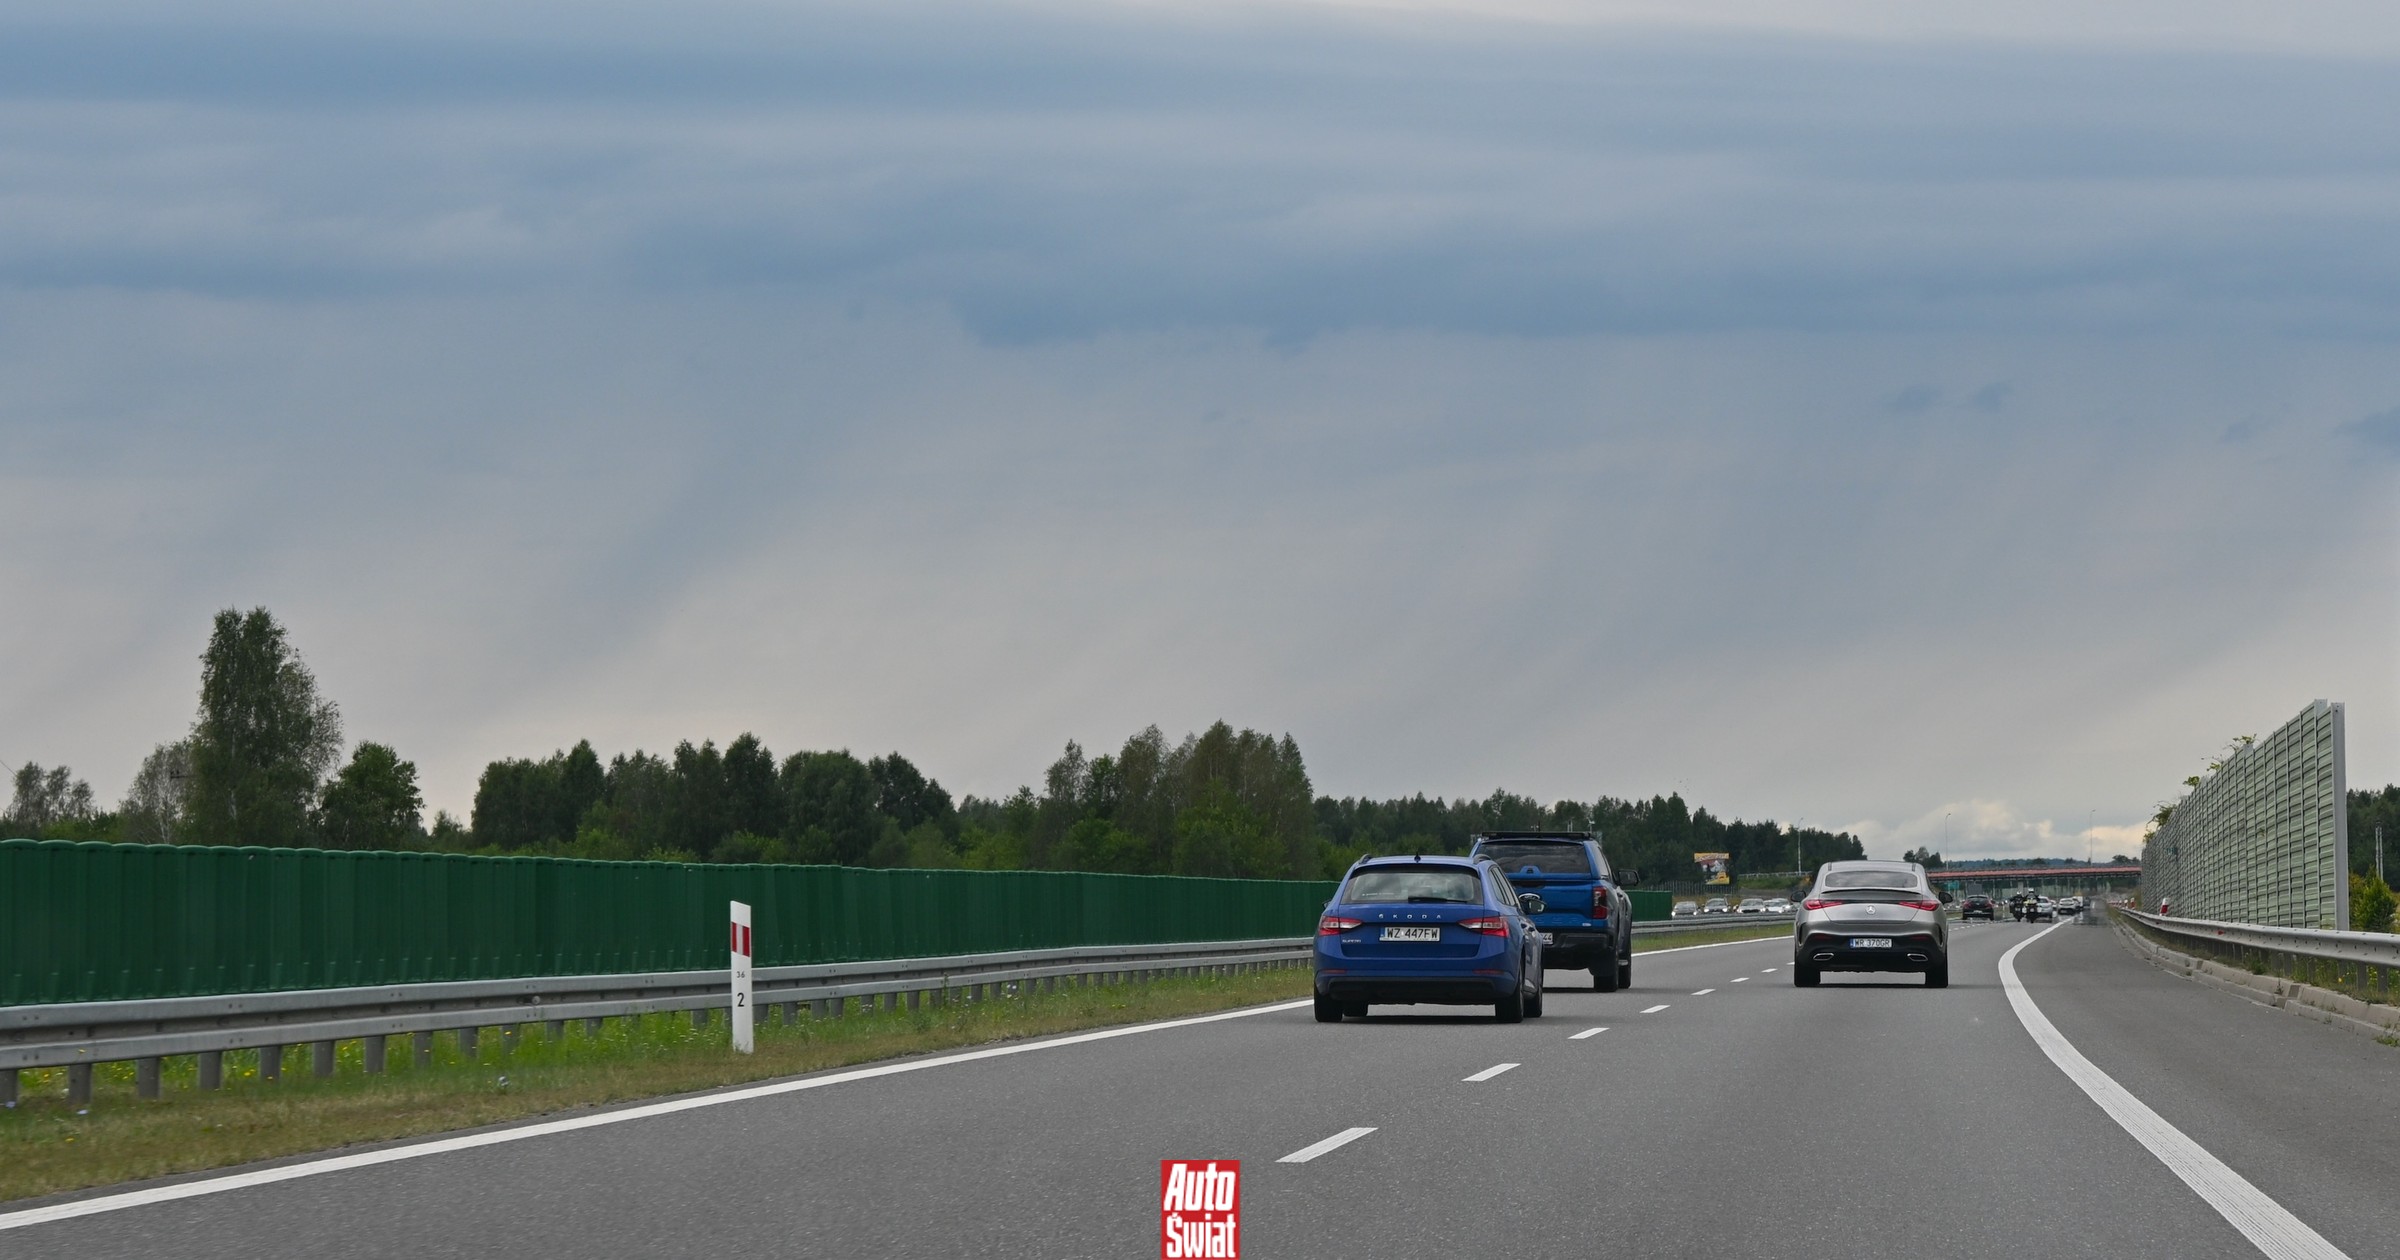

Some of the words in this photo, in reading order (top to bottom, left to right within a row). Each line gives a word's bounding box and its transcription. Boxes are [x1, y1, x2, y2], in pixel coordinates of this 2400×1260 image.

[1387, 928, 1401, 939] WZ
[1404, 928, 1438, 939] 447FW
[737, 992, 745, 1007] 2
